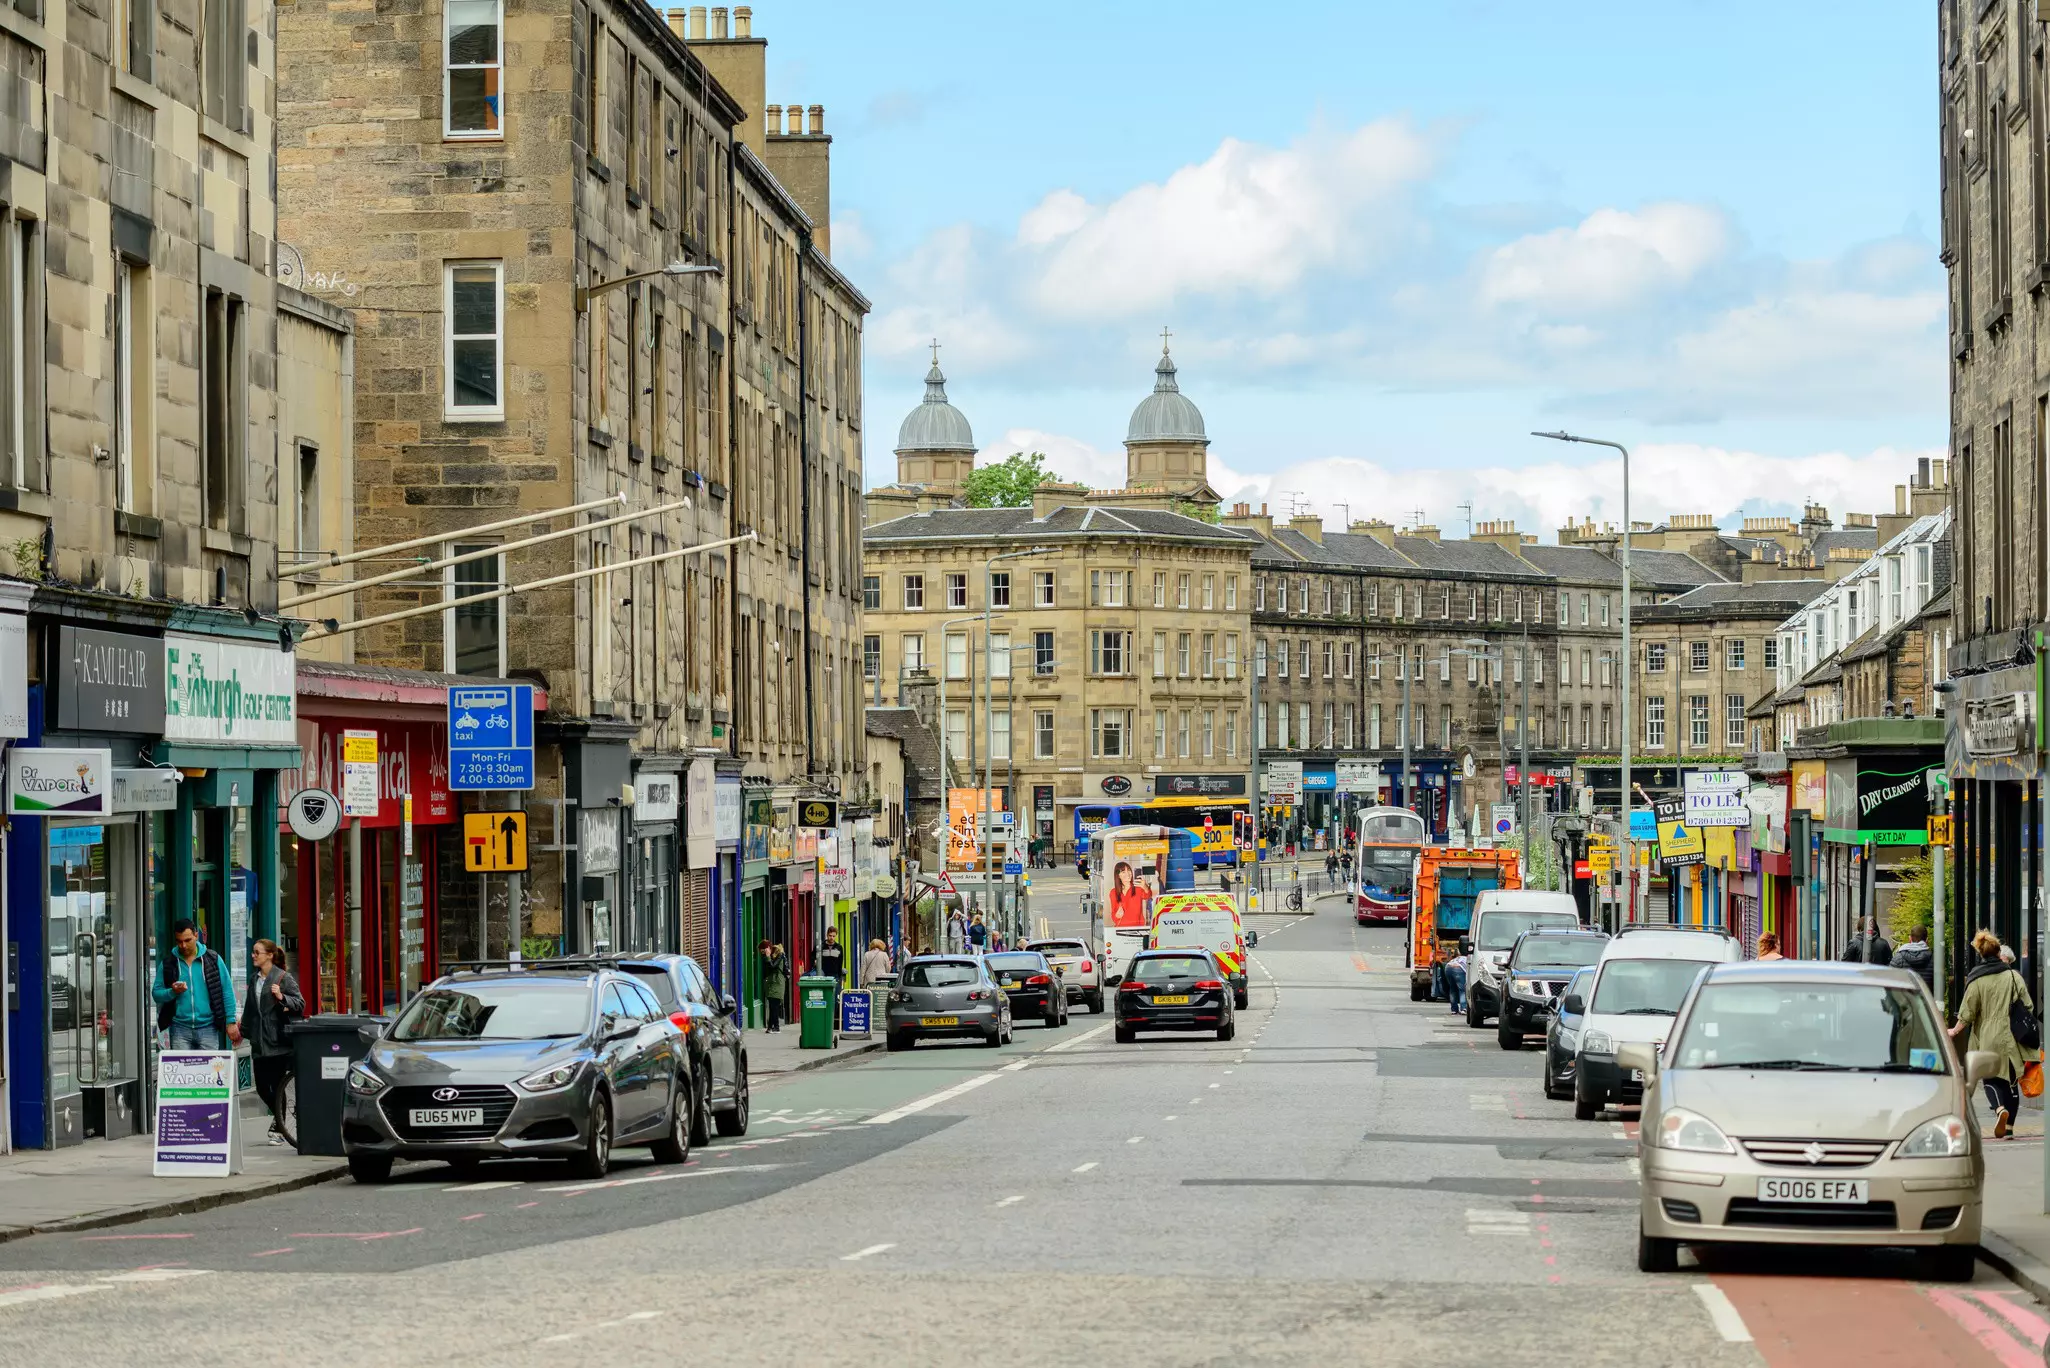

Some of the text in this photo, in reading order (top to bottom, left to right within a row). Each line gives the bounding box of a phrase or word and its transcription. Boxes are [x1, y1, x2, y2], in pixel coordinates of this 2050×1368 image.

[83, 643, 147, 689] KAMI HAIR
[243, 693, 262, 720] GOLF
[265, 694, 291, 721] CENTRE
[455, 731, 473, 740] taxi
[321, 732, 333, 792] &
[471, 753, 511, 762] Mon-Fri
[21, 766, 38, 778] Dr
[460, 764, 524, 773] 7.30-9.30am
[459, 775, 525, 785] 4.00-6.30pm
[1308, 776, 1328, 784] GREGGS
[1704, 773, 1730, 783] DMB
[1690, 795, 1711, 807] TO
[1859, 775, 1921, 816] DRY CLEANING
[1657, 803, 1674, 815] TO
[960, 813, 975, 824] ed
[953, 825, 975, 836] film
[1079, 823, 1102, 831] FREE
[1204, 830, 1222, 844] 900
[1665, 837, 1697, 847] SHEPHERD
[1873, 832, 1907, 842] NEXT DAY
[951, 837, 975, 849] fest
[164, 1063, 178, 1073] Dr
[415, 1110, 477, 1123] EU65 MVP
[1822, 1182, 1859, 1199] EFA
